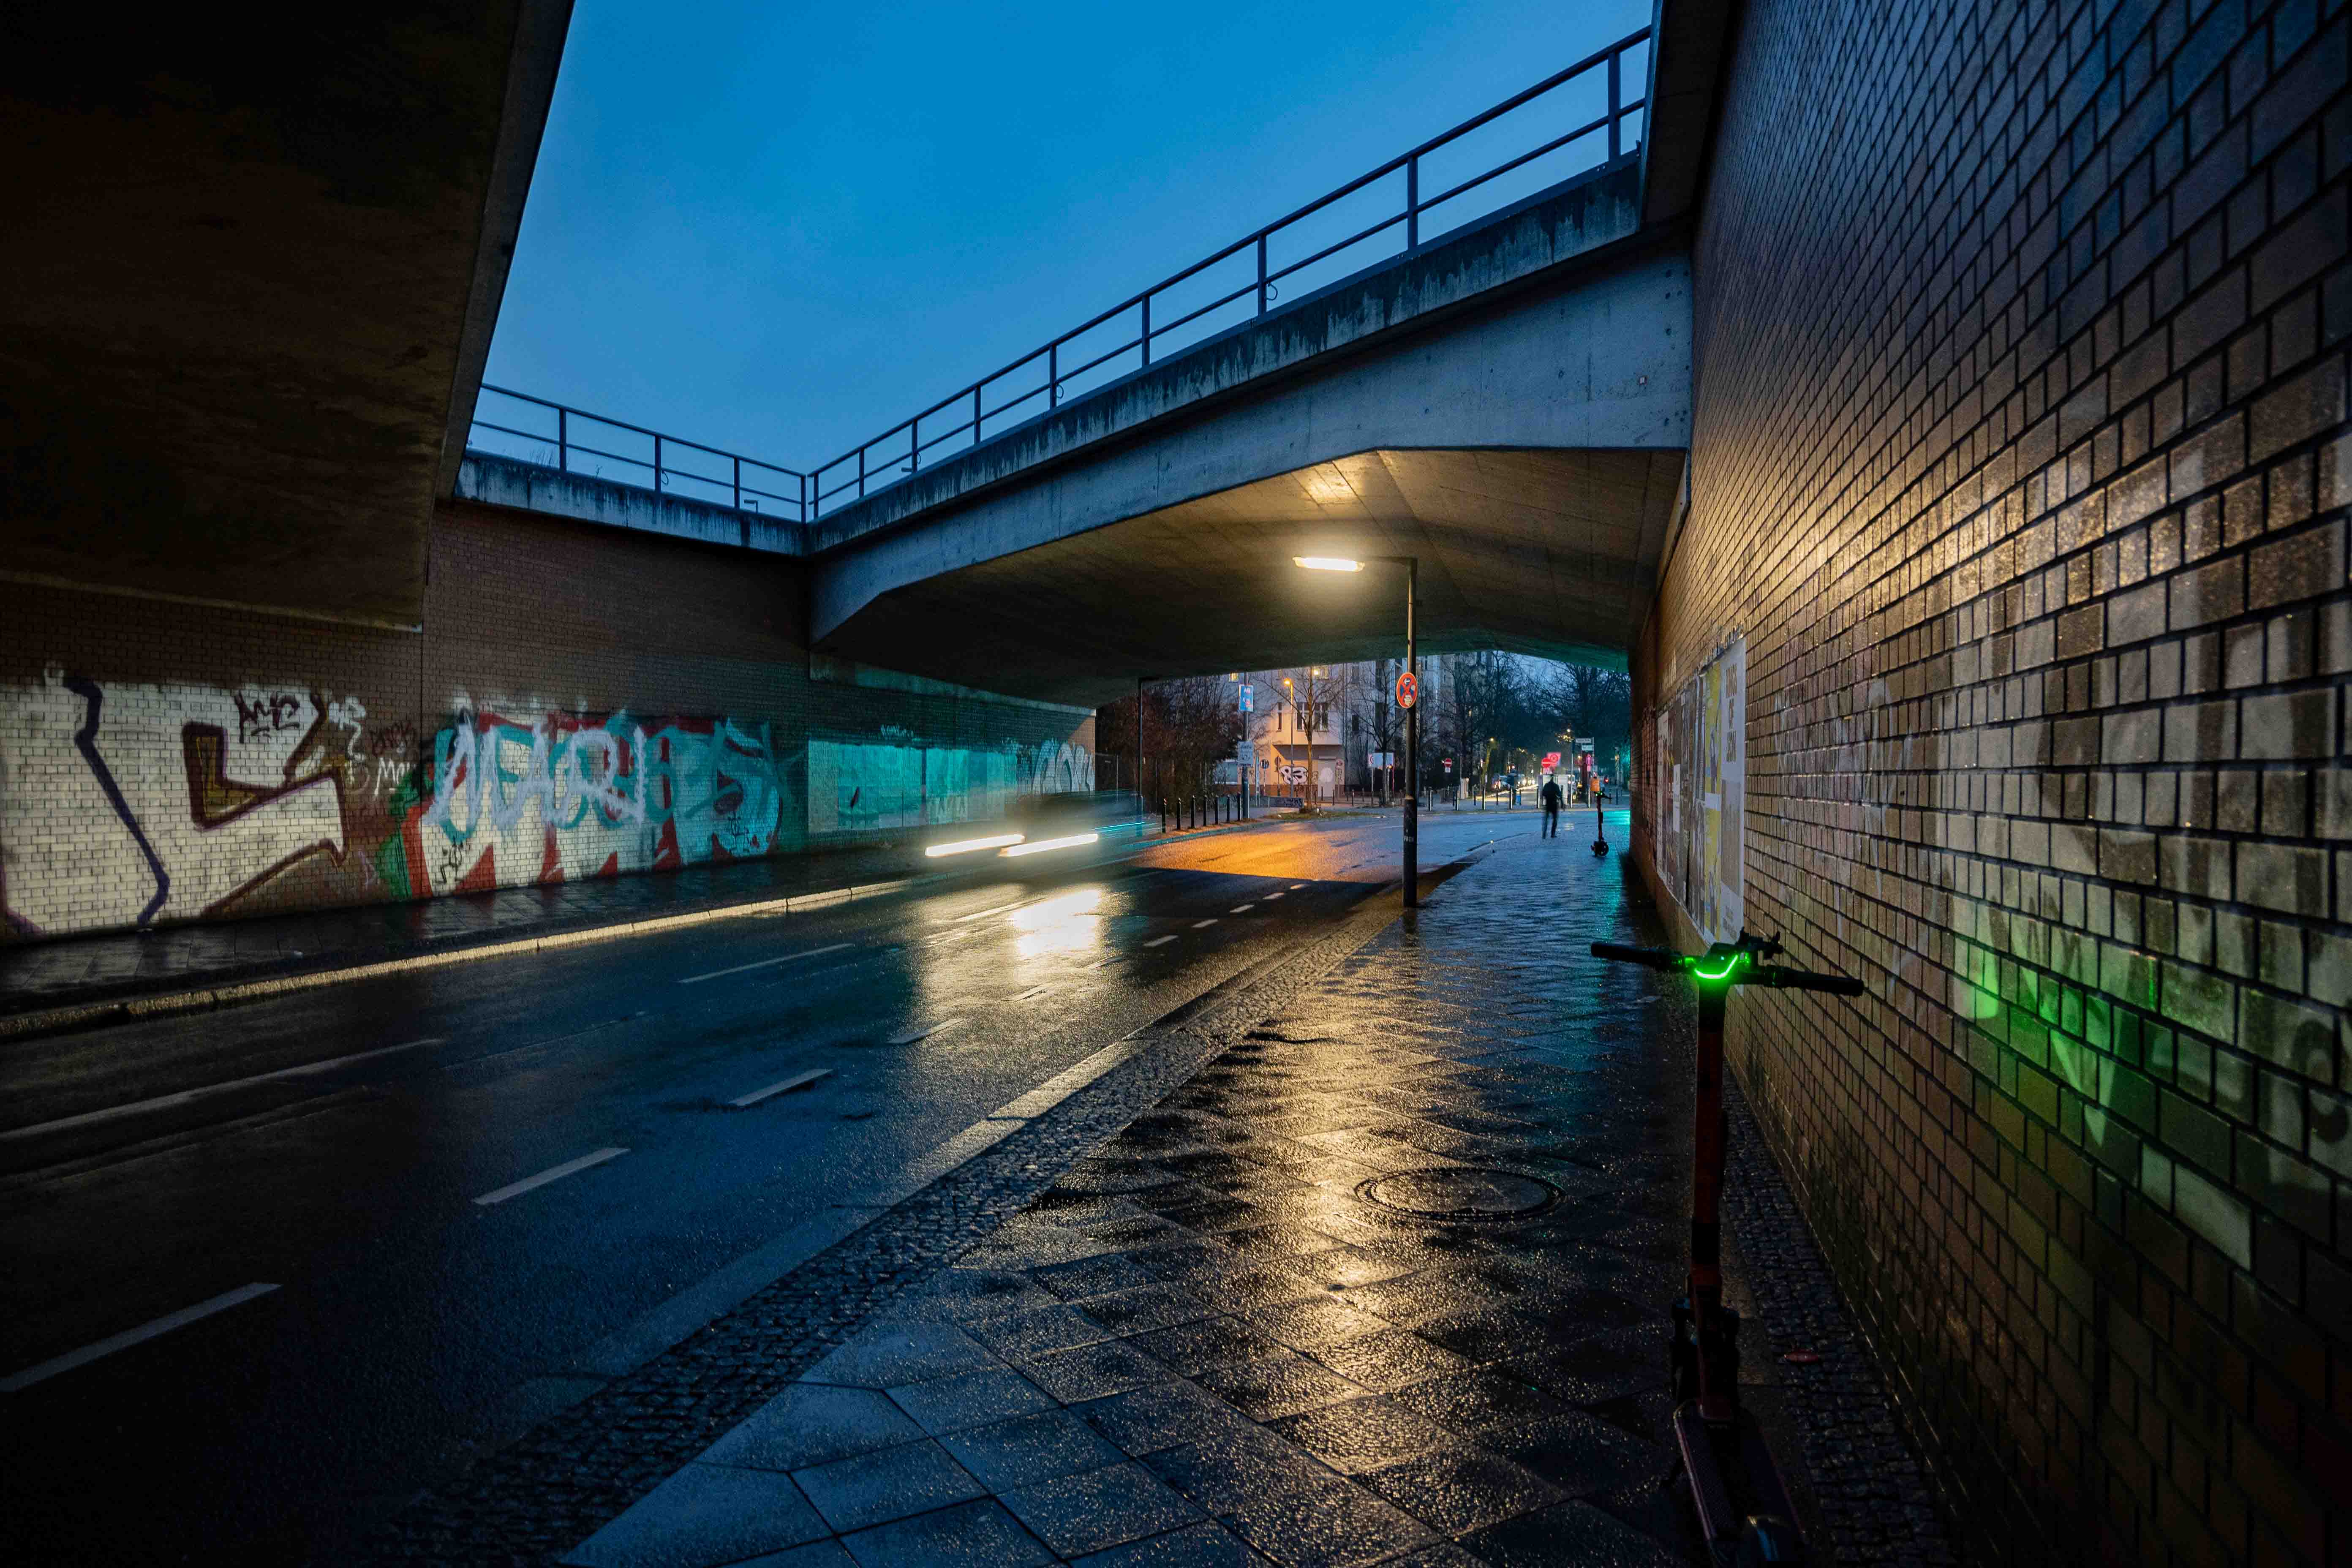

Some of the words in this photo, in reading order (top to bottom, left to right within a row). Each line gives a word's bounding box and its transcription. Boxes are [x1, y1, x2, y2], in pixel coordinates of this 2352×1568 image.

[1726, 663, 1737, 697] KINGS
[1729, 698, 1734, 729] OF
[1726, 730, 1737, 762] LEON
